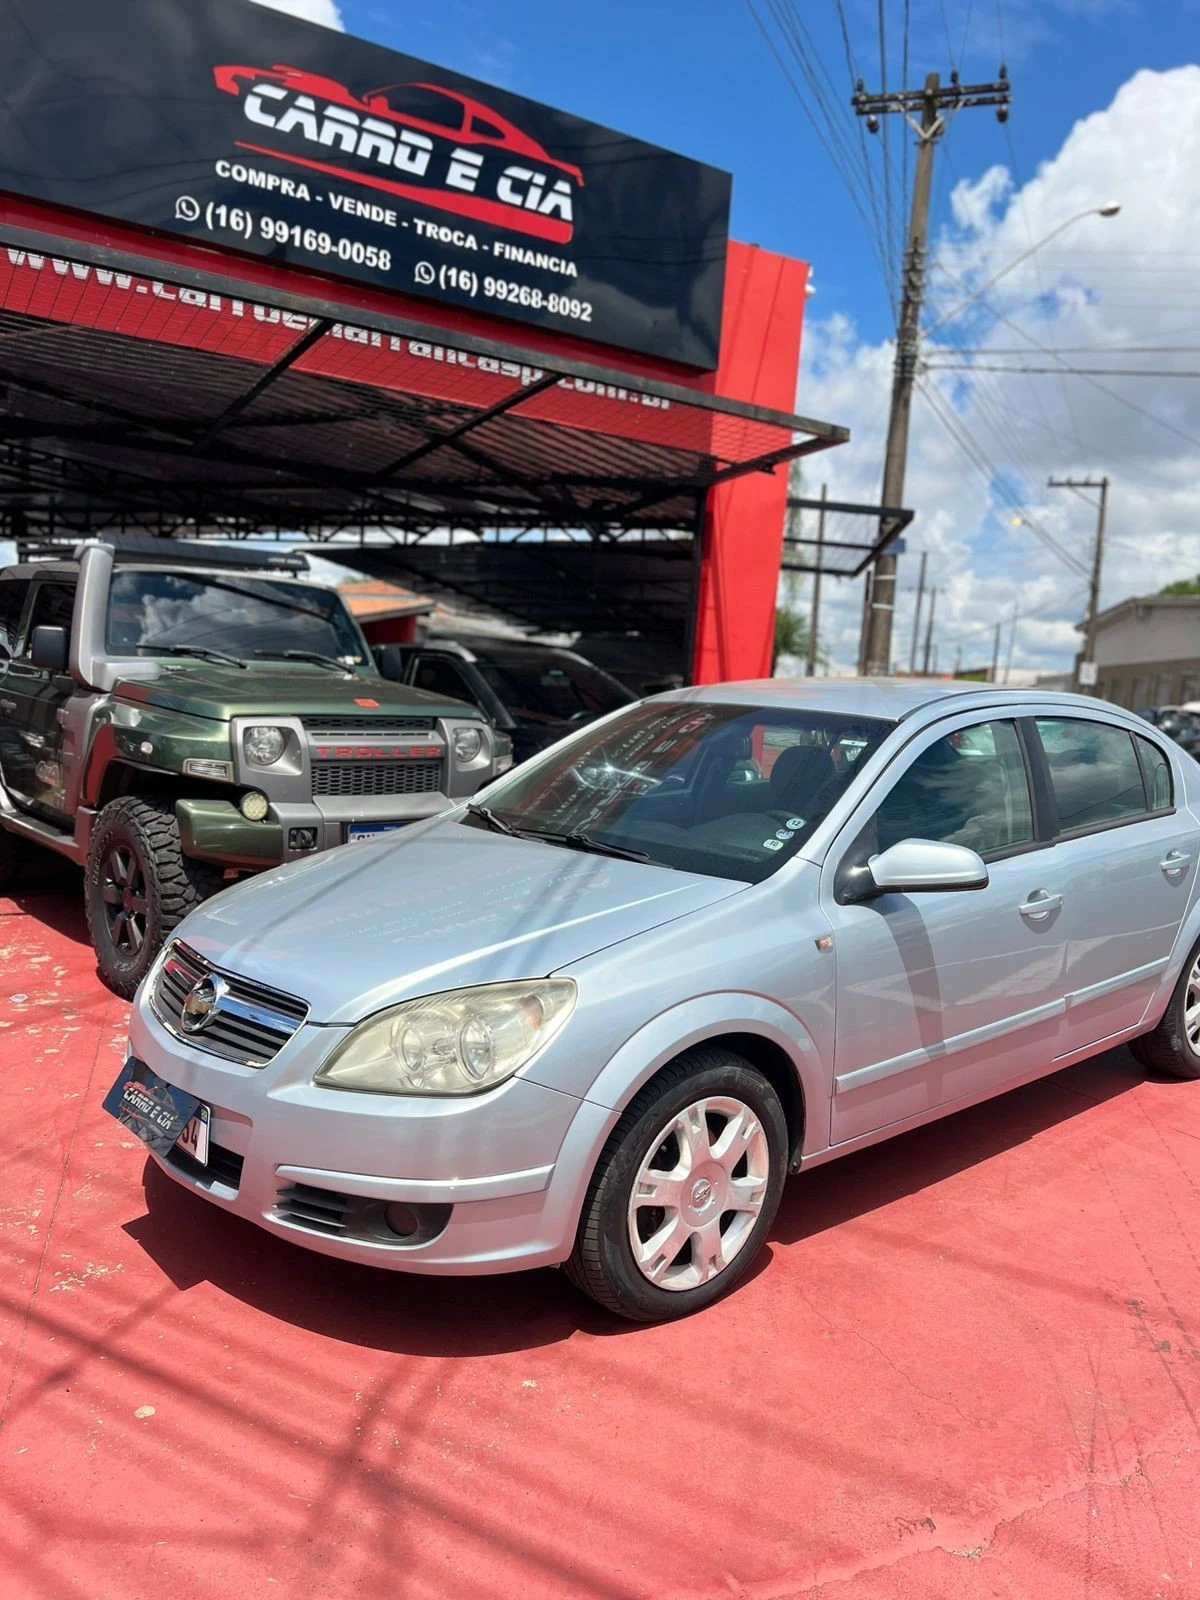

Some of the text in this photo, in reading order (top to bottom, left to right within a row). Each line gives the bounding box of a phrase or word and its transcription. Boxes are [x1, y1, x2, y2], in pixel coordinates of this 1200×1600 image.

[243, 84, 573, 221] CARRO E CIA
[206, 201, 391, 272] (16) 99169-0058
[215, 160, 310, 202] COMPRA
[329, 194, 397, 227] VENDE
[413, 218, 477, 251] TROCA
[494, 241, 577, 278] FINANCIA
[439, 264, 592, 323] (16) 99268-8092
[316, 745, 441, 759] TROLLER
[123, 1088, 174, 1130] CARRO E CIA
